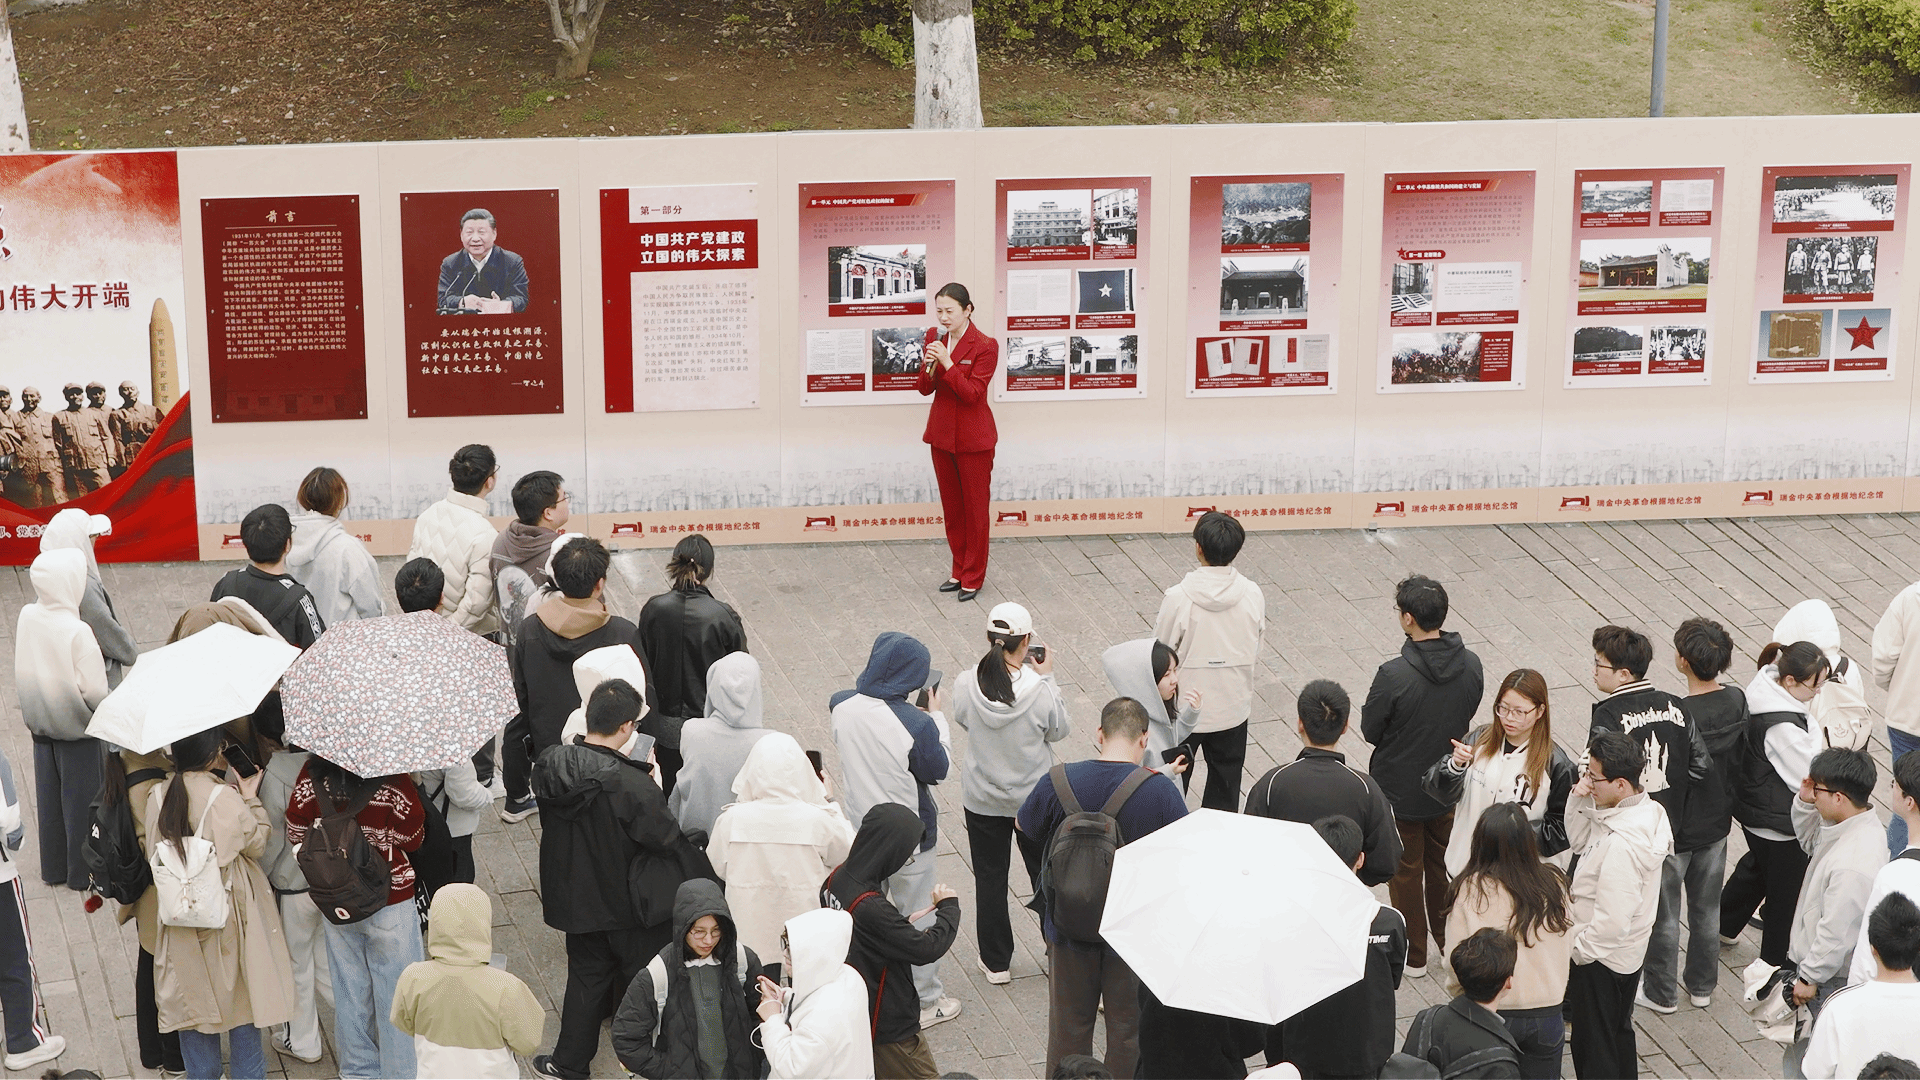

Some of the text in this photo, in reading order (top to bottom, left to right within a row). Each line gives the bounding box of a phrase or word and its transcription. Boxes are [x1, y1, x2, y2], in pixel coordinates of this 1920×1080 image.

[640, 205, 682, 216] 第一部分
[640, 230, 745, 247] 中国共产党建政
[640, 248, 745, 264] 立国的伟大探索
[1596, 496, 1702, 508] 瑞金中央革命根据地纪念馆
[1779, 490, 1884, 502] 瑞金中央革命根据地纪念馆
[1411, 501, 1518, 513] 瑞金中央革命根据地纪念馆
[1033, 511, 1144, 522] 瑞金中央革命根据地纪念馆
[650, 521, 760, 534] 瑞金中央革命根据地纪念馆
